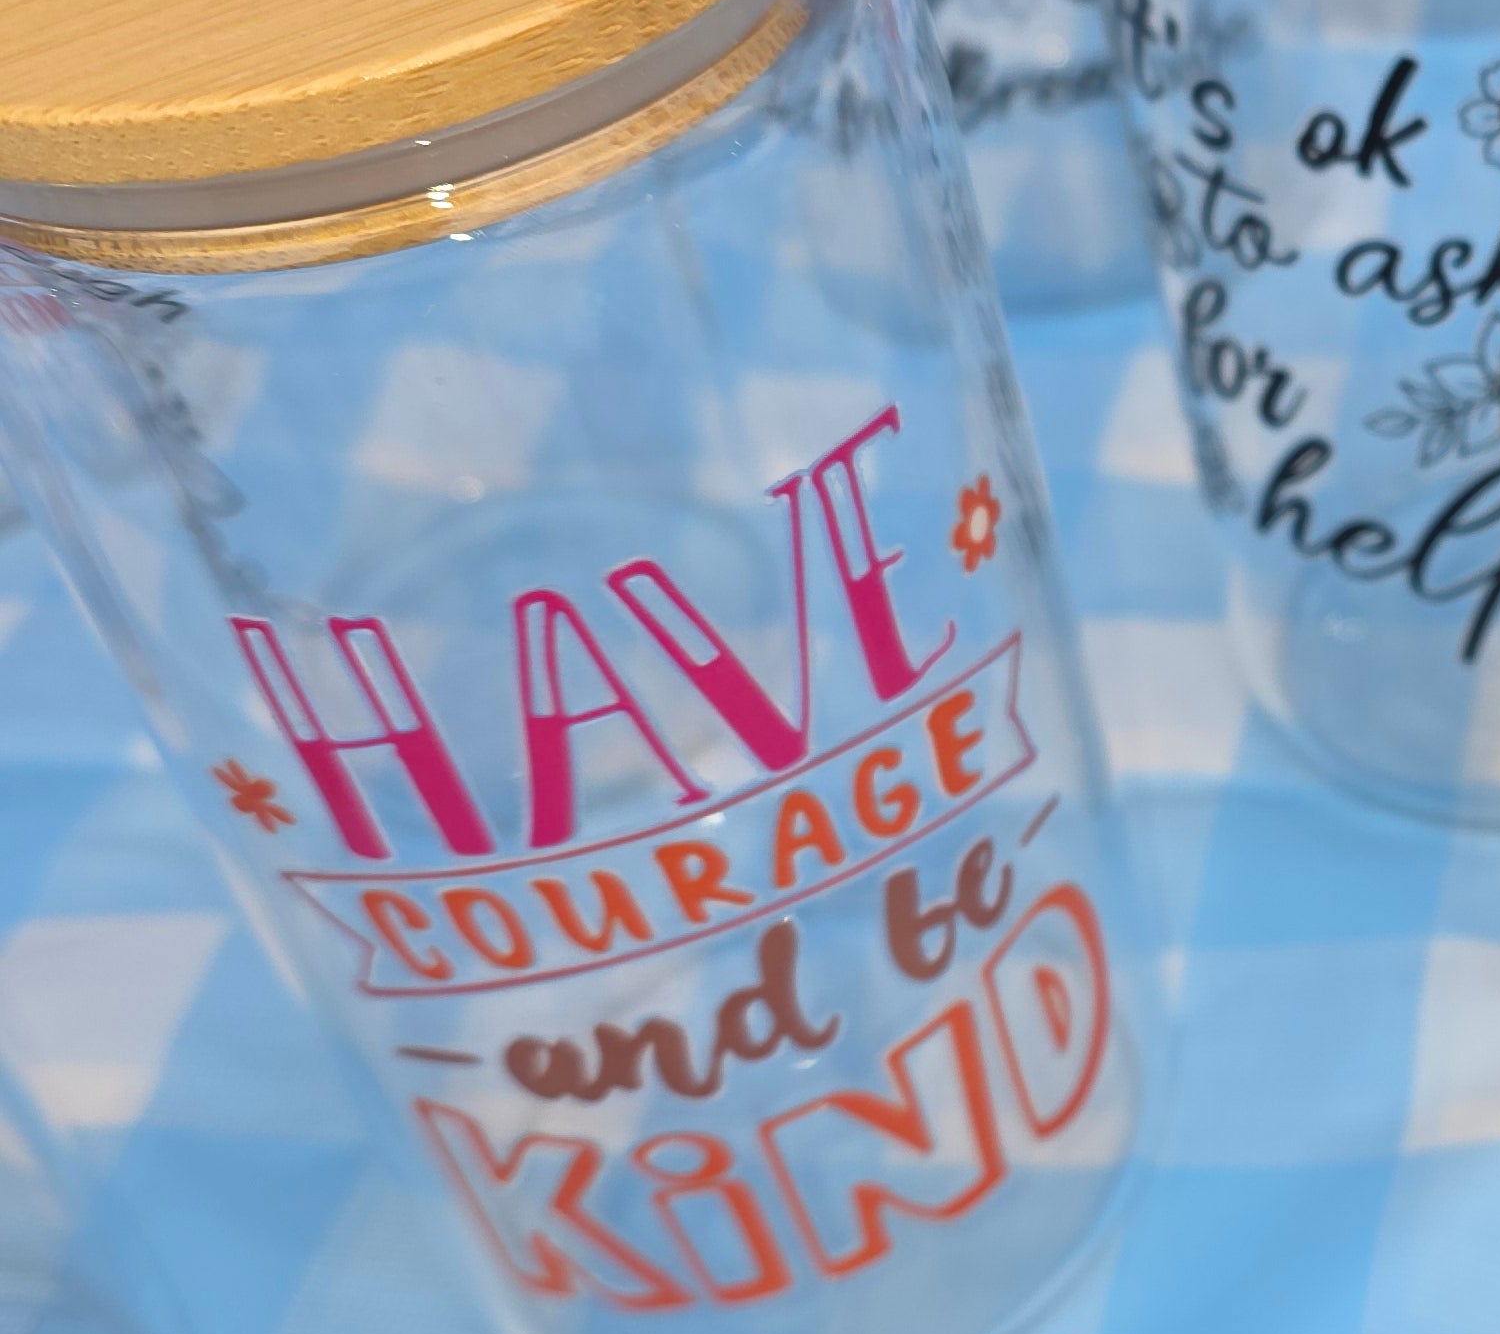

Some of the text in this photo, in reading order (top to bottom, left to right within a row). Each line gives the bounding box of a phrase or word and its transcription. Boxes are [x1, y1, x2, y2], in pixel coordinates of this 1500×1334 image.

[1173, 147, 1299, 270] to
[1297, 55, 1429, 188] ok
[1181, 278, 1309, 430] for
[228, 403, 957, 863] HAVE
[360, 687, 986, 981] COURAGE
[502, 834, 1018, 1103] and be
